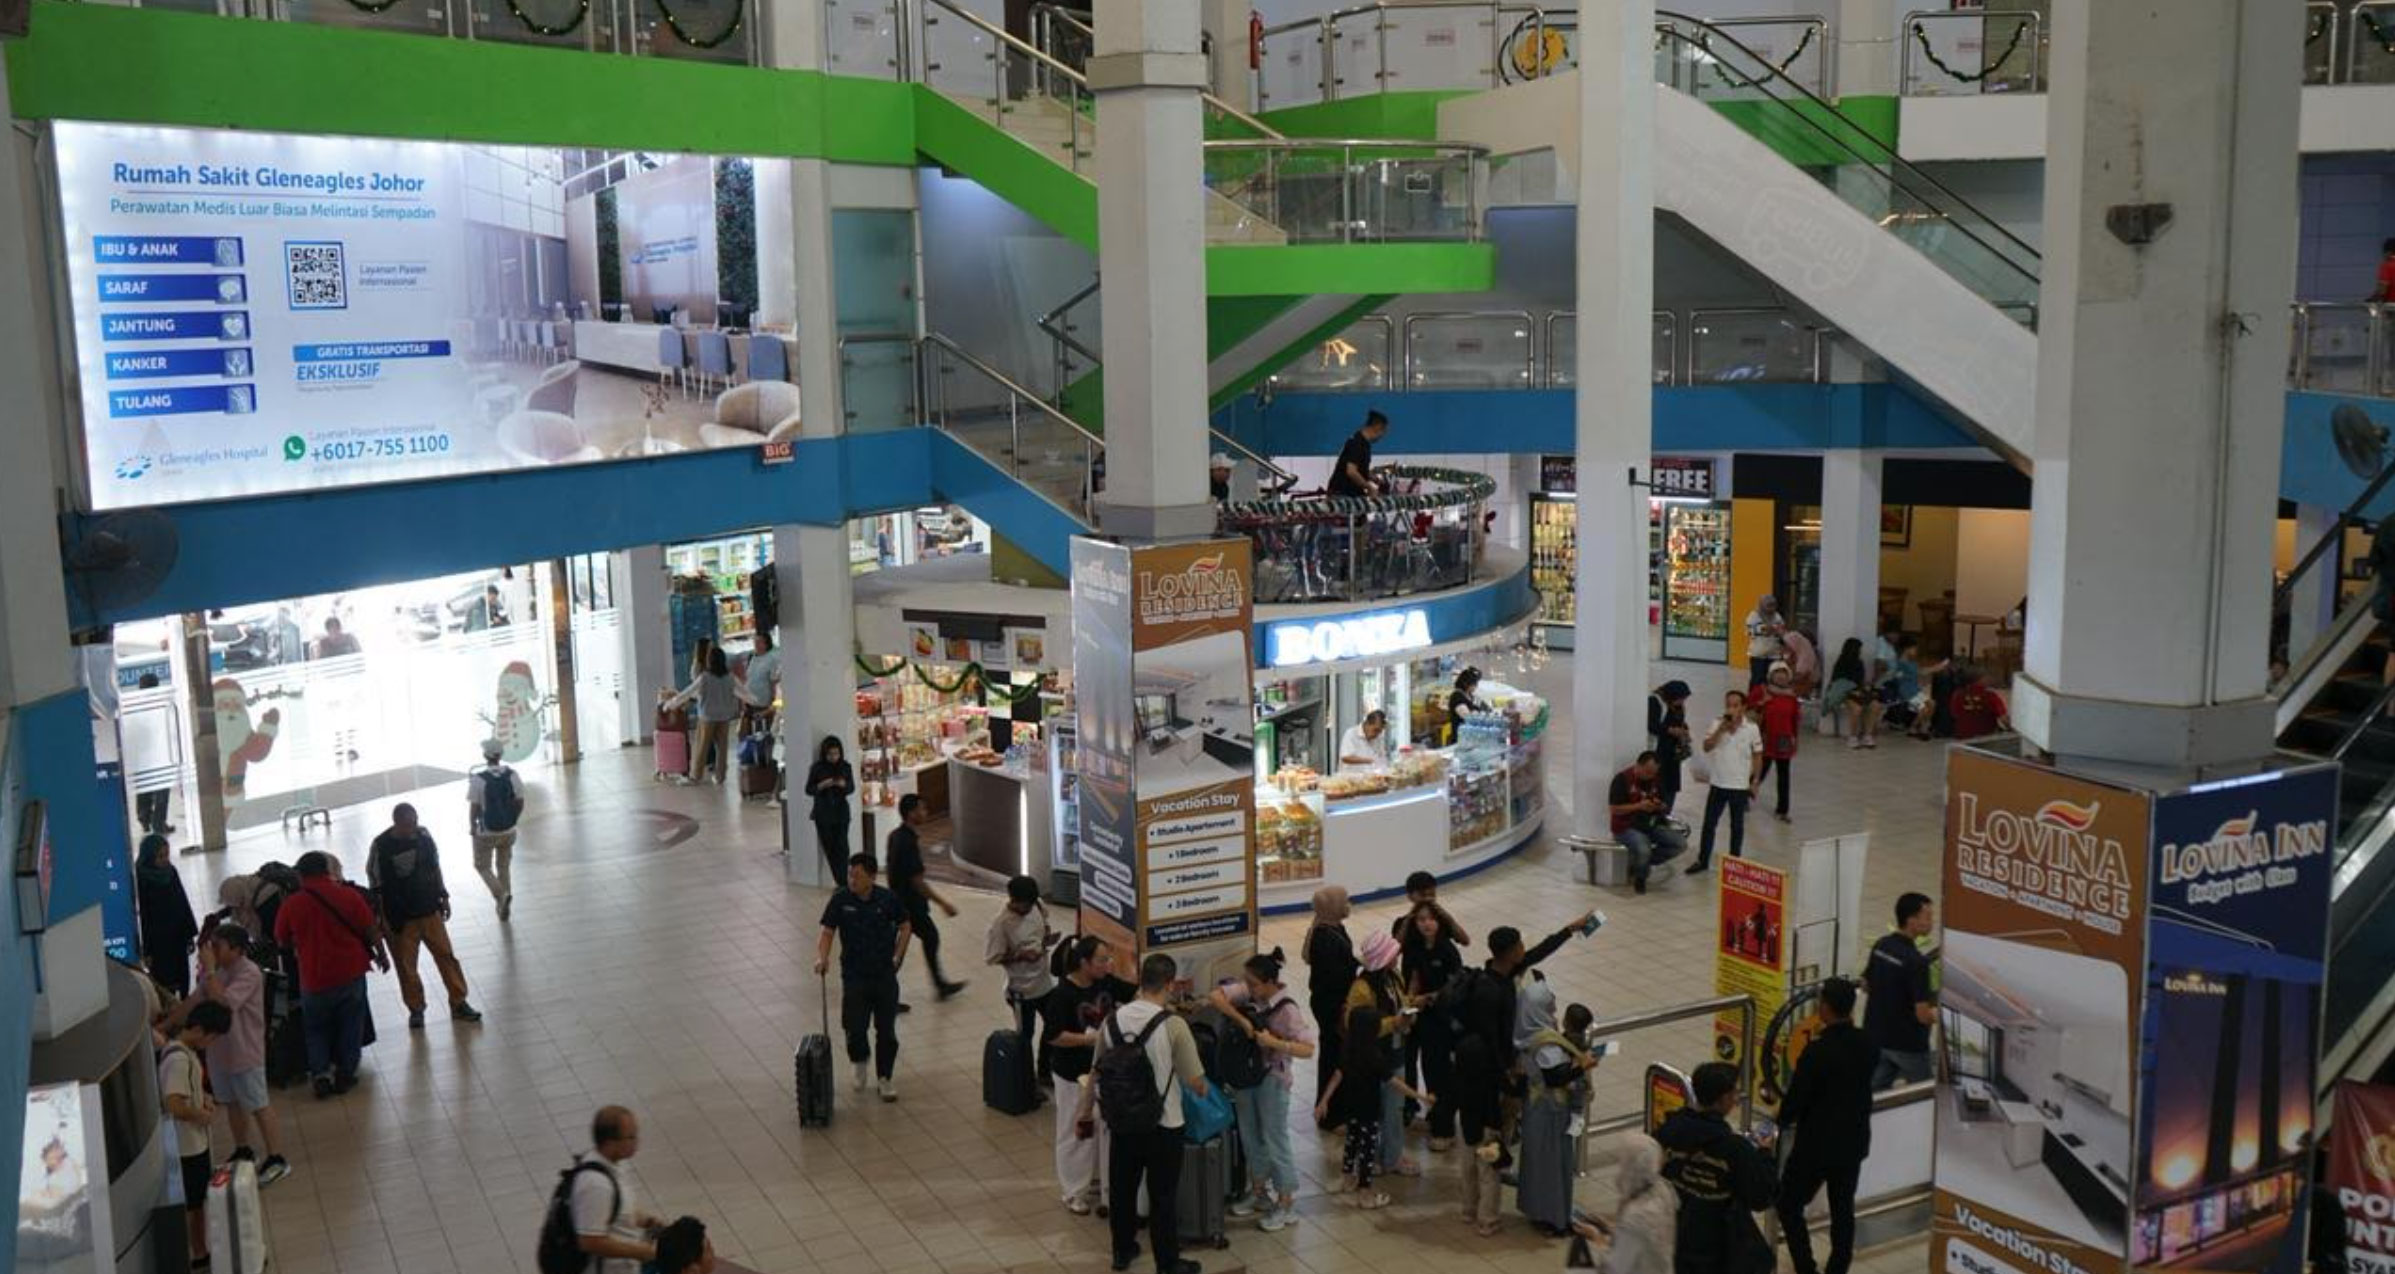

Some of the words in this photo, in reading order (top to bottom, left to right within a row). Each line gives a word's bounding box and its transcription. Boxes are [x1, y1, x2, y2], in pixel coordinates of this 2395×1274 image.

[113, 162, 192, 185] Rumah
[198, 164, 250, 187] Sakit
[255, 167, 366, 194] Gleneagles
[370, 172, 425, 193] Johor
[110, 199, 190, 215] Perawatan
[193, 199, 236, 217] Medis
[238, 201, 269, 216] Luar
[272, 202, 308, 217] Biasa
[311, 203, 369, 218] Melintasi
[371, 205, 436, 222] Sempadan
[101, 243, 125, 256] IBU
[128, 243, 139, 256] &
[141, 243, 178, 256] ANAK
[105, 280, 149, 295] SARAF
[108, 319, 175, 334] JANTUNG
[317, 345, 353, 358] GRATIS
[356, 343, 430, 356] TRANSPORTASI
[112, 357, 168, 372] KANKER
[296, 362, 381, 381] EKSKLUSIF
[116, 395, 173, 409] TULANG
[159, 449, 221, 466] Gleneagles
[223, 445, 269, 462] Hospital
[310, 437, 405, 463] +6017-755
[409, 434, 450, 454] 1100
[1653, 468, 1708, 493] FREE
[1139, 567, 1244, 600] LOVINA
[1140, 590, 1244, 616] RESIDENCE
[1150, 796, 1210, 816] Vacation
[1211, 793, 1241, 809] Stay
[1180, 846, 1219, 858] Bedroom
[1958, 791, 2132, 891] LOVINA
[2161, 830, 2272, 885] LOVINA
[2273, 819, 2328, 863] INN
[1180, 870, 1219, 883] Bedroom
[1957, 843, 2131, 919] RESIDENCE
[2187, 878, 2233, 905] Budget
[2234, 870, 2264, 894] with
[1181, 896, 1221, 908] Bedroom
[2164, 976, 2207, 994] LOVINA
[2338, 1186, 2395, 1221] PO
[1954, 1202, 2047, 1268] Vacation
